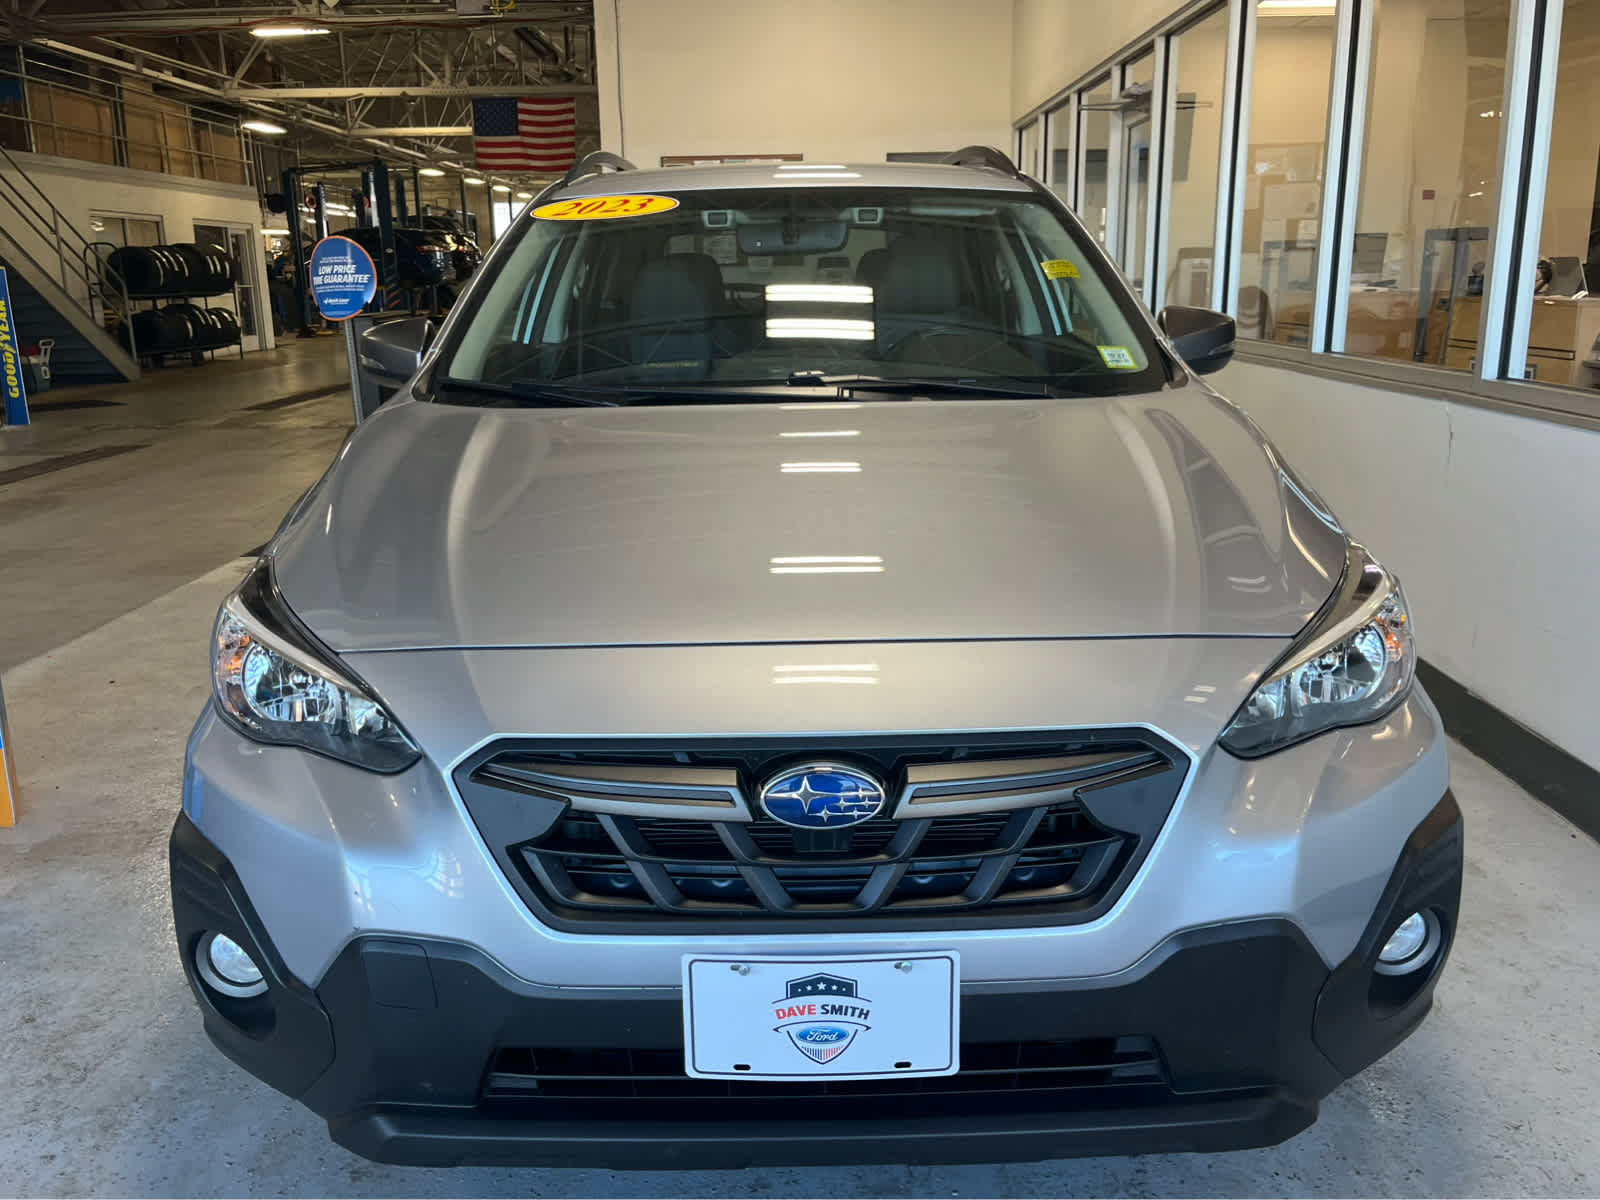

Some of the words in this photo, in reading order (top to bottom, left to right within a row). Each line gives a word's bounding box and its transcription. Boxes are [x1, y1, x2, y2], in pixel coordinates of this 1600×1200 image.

[552, 198, 654, 216] 2023
[319, 265, 332, 275] LOW
[333, 264, 356, 273] PRICE
[323, 274, 369, 283] GUARANTEE
[0, 299, 20, 399] GOODYEAR
[776, 1003, 816, 1020] DAVE
[820, 1003, 870, 1020] SMITH
[806, 1030, 839, 1041] Ford
